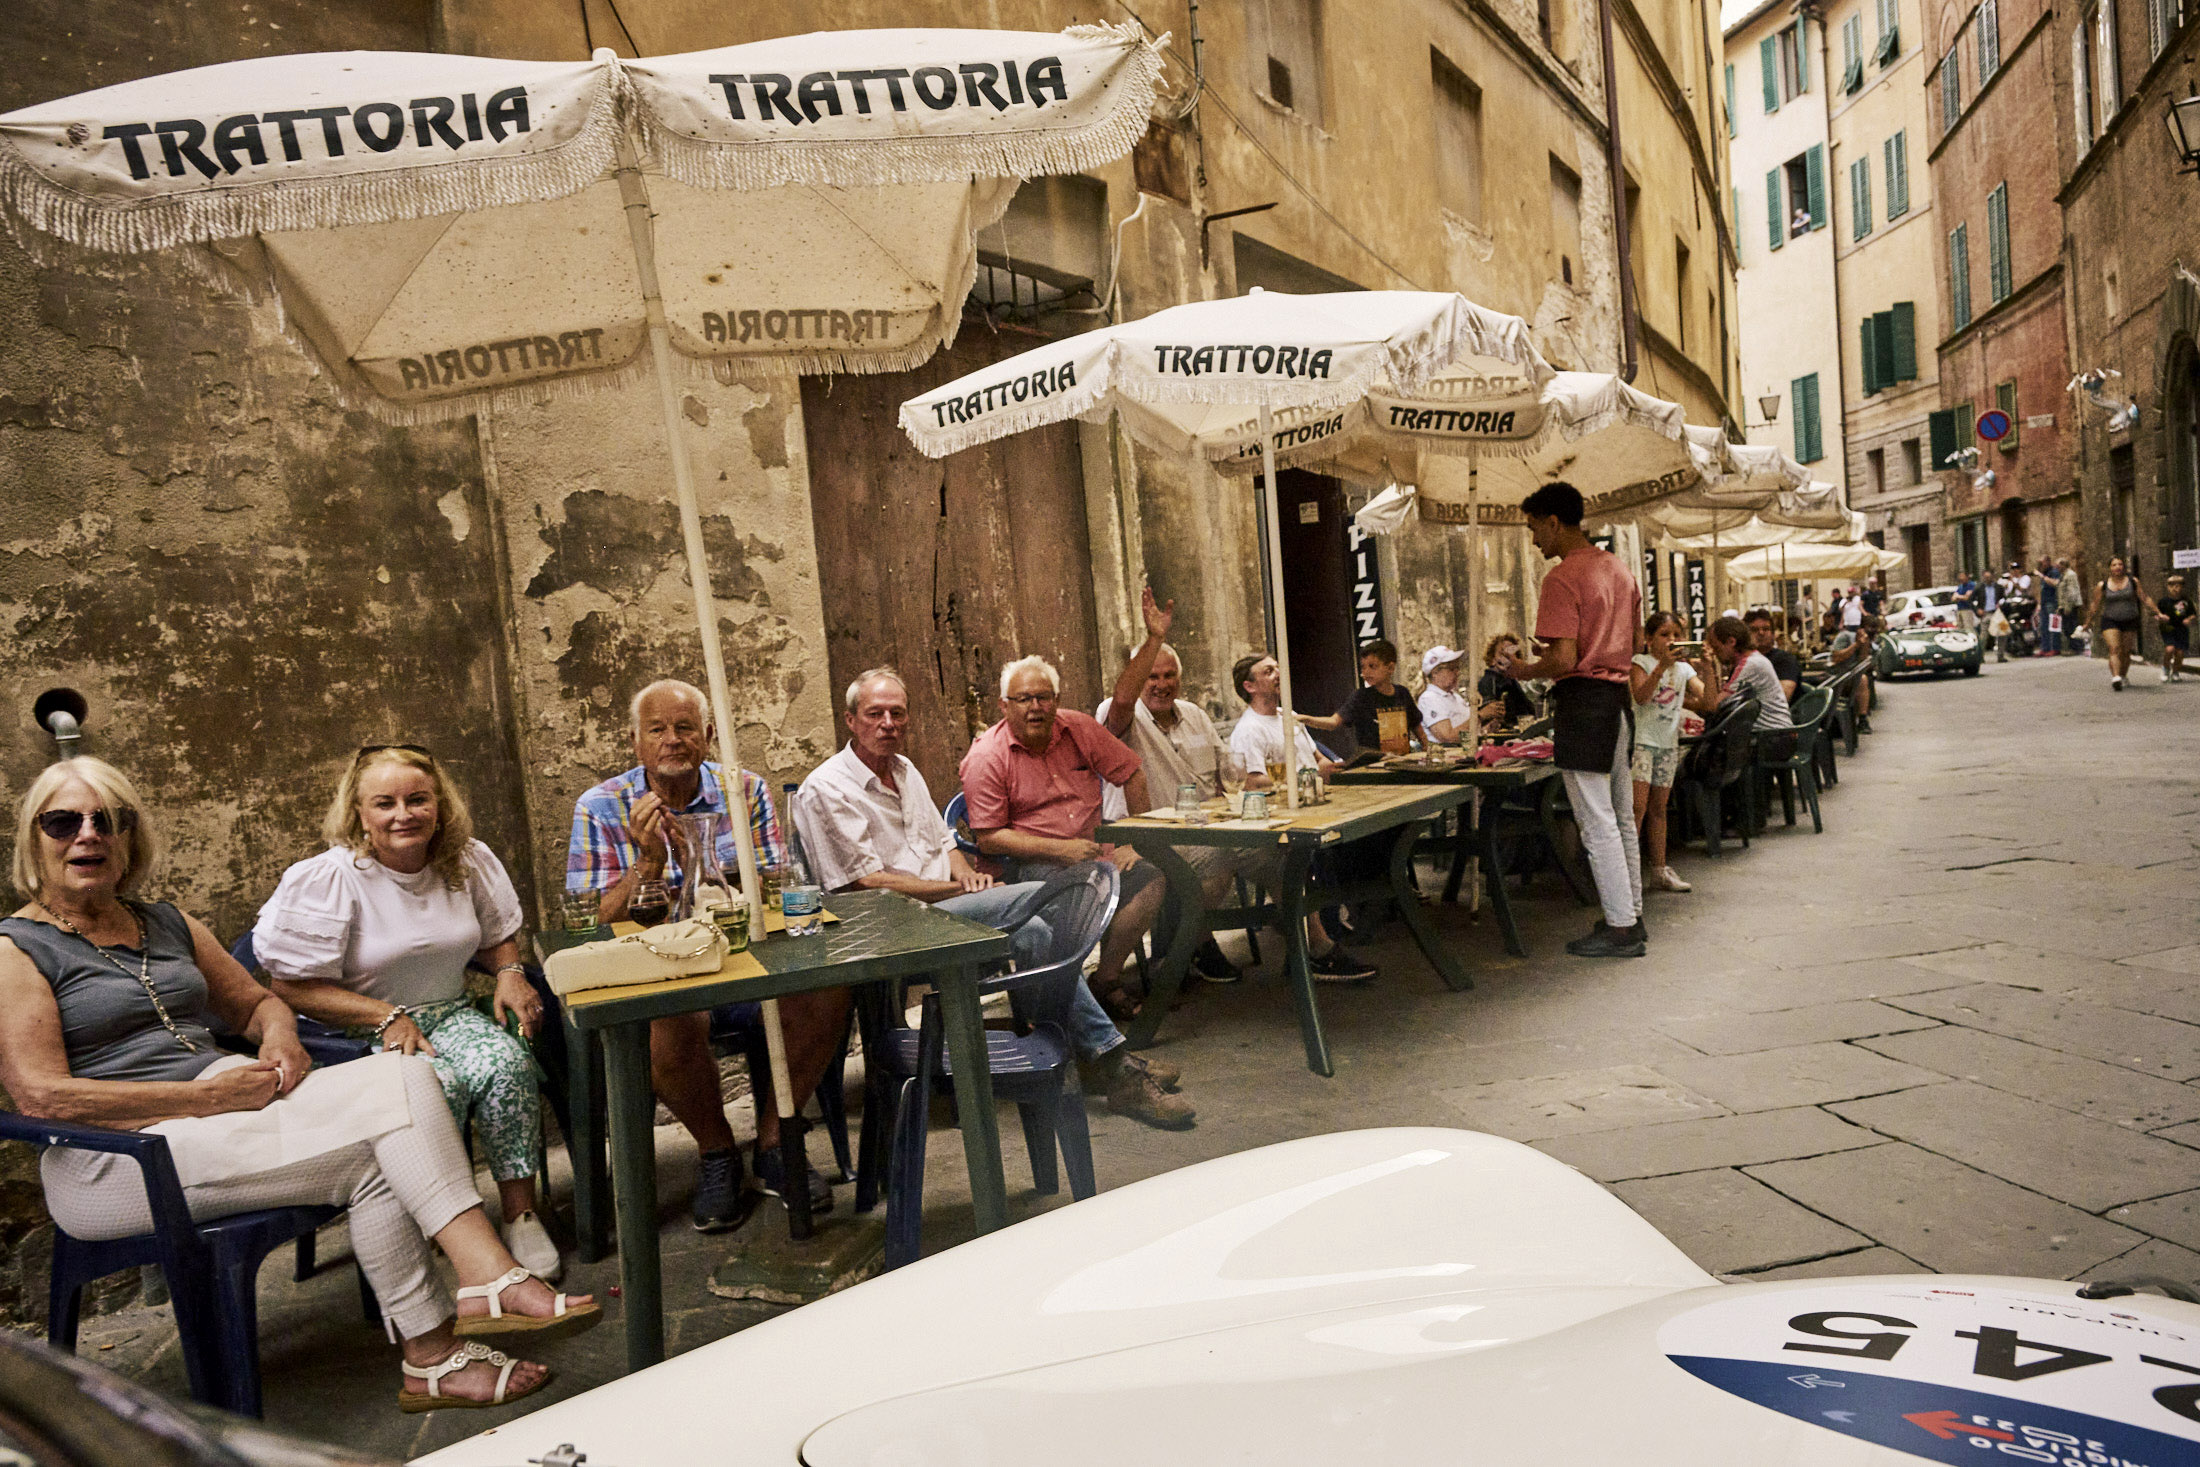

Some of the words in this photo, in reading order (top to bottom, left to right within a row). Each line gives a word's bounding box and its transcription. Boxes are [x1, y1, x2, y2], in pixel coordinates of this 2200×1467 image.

[709, 56, 1069, 126] TRATTORIA
[103, 86, 531, 180] TRATTORIA
[931, 360, 1077, 428] TRATTORIA
[1155, 344, 1333, 379] TRATTORIA
[1390, 406, 1516, 434] TRATTORIA
[1347, 522, 1381, 648] PIZZ
